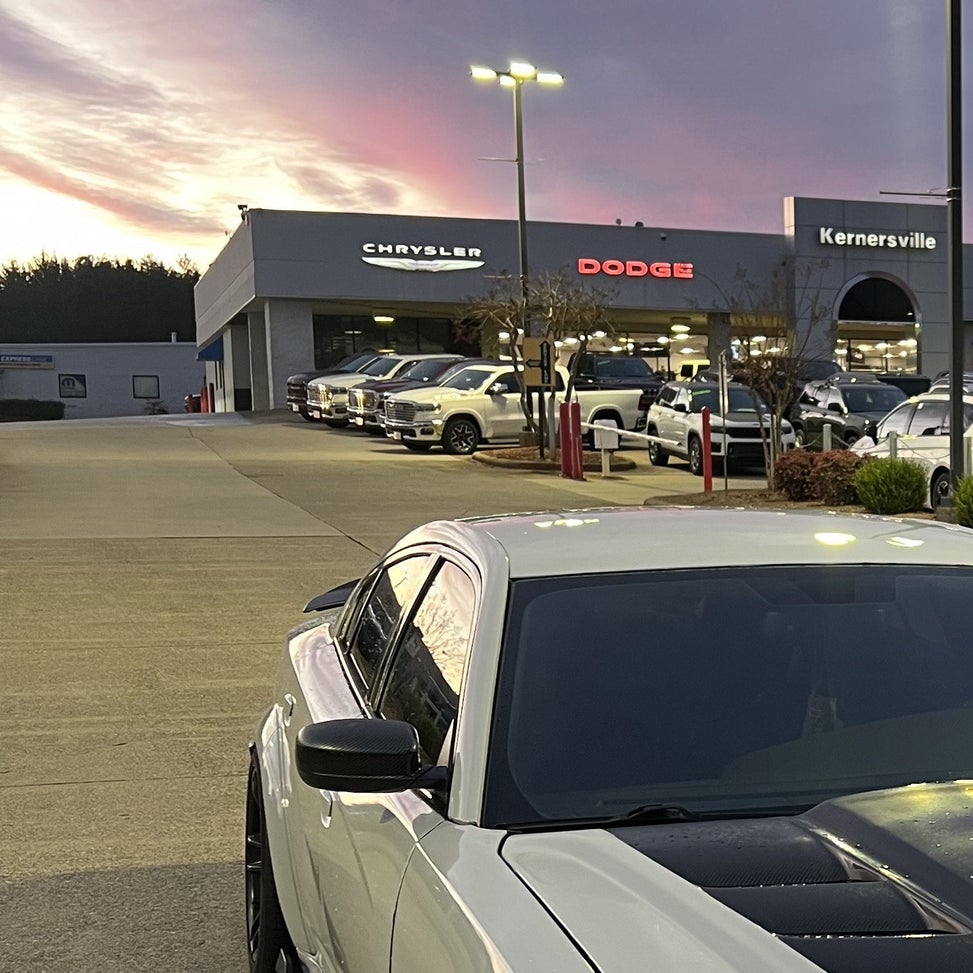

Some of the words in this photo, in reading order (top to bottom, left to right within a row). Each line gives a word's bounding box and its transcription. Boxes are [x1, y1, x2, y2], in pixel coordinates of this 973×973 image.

[819, 227, 937, 250] Kernersville
[362, 243, 482, 257] CHRYSLER
[577, 258, 694, 280] DODGE
